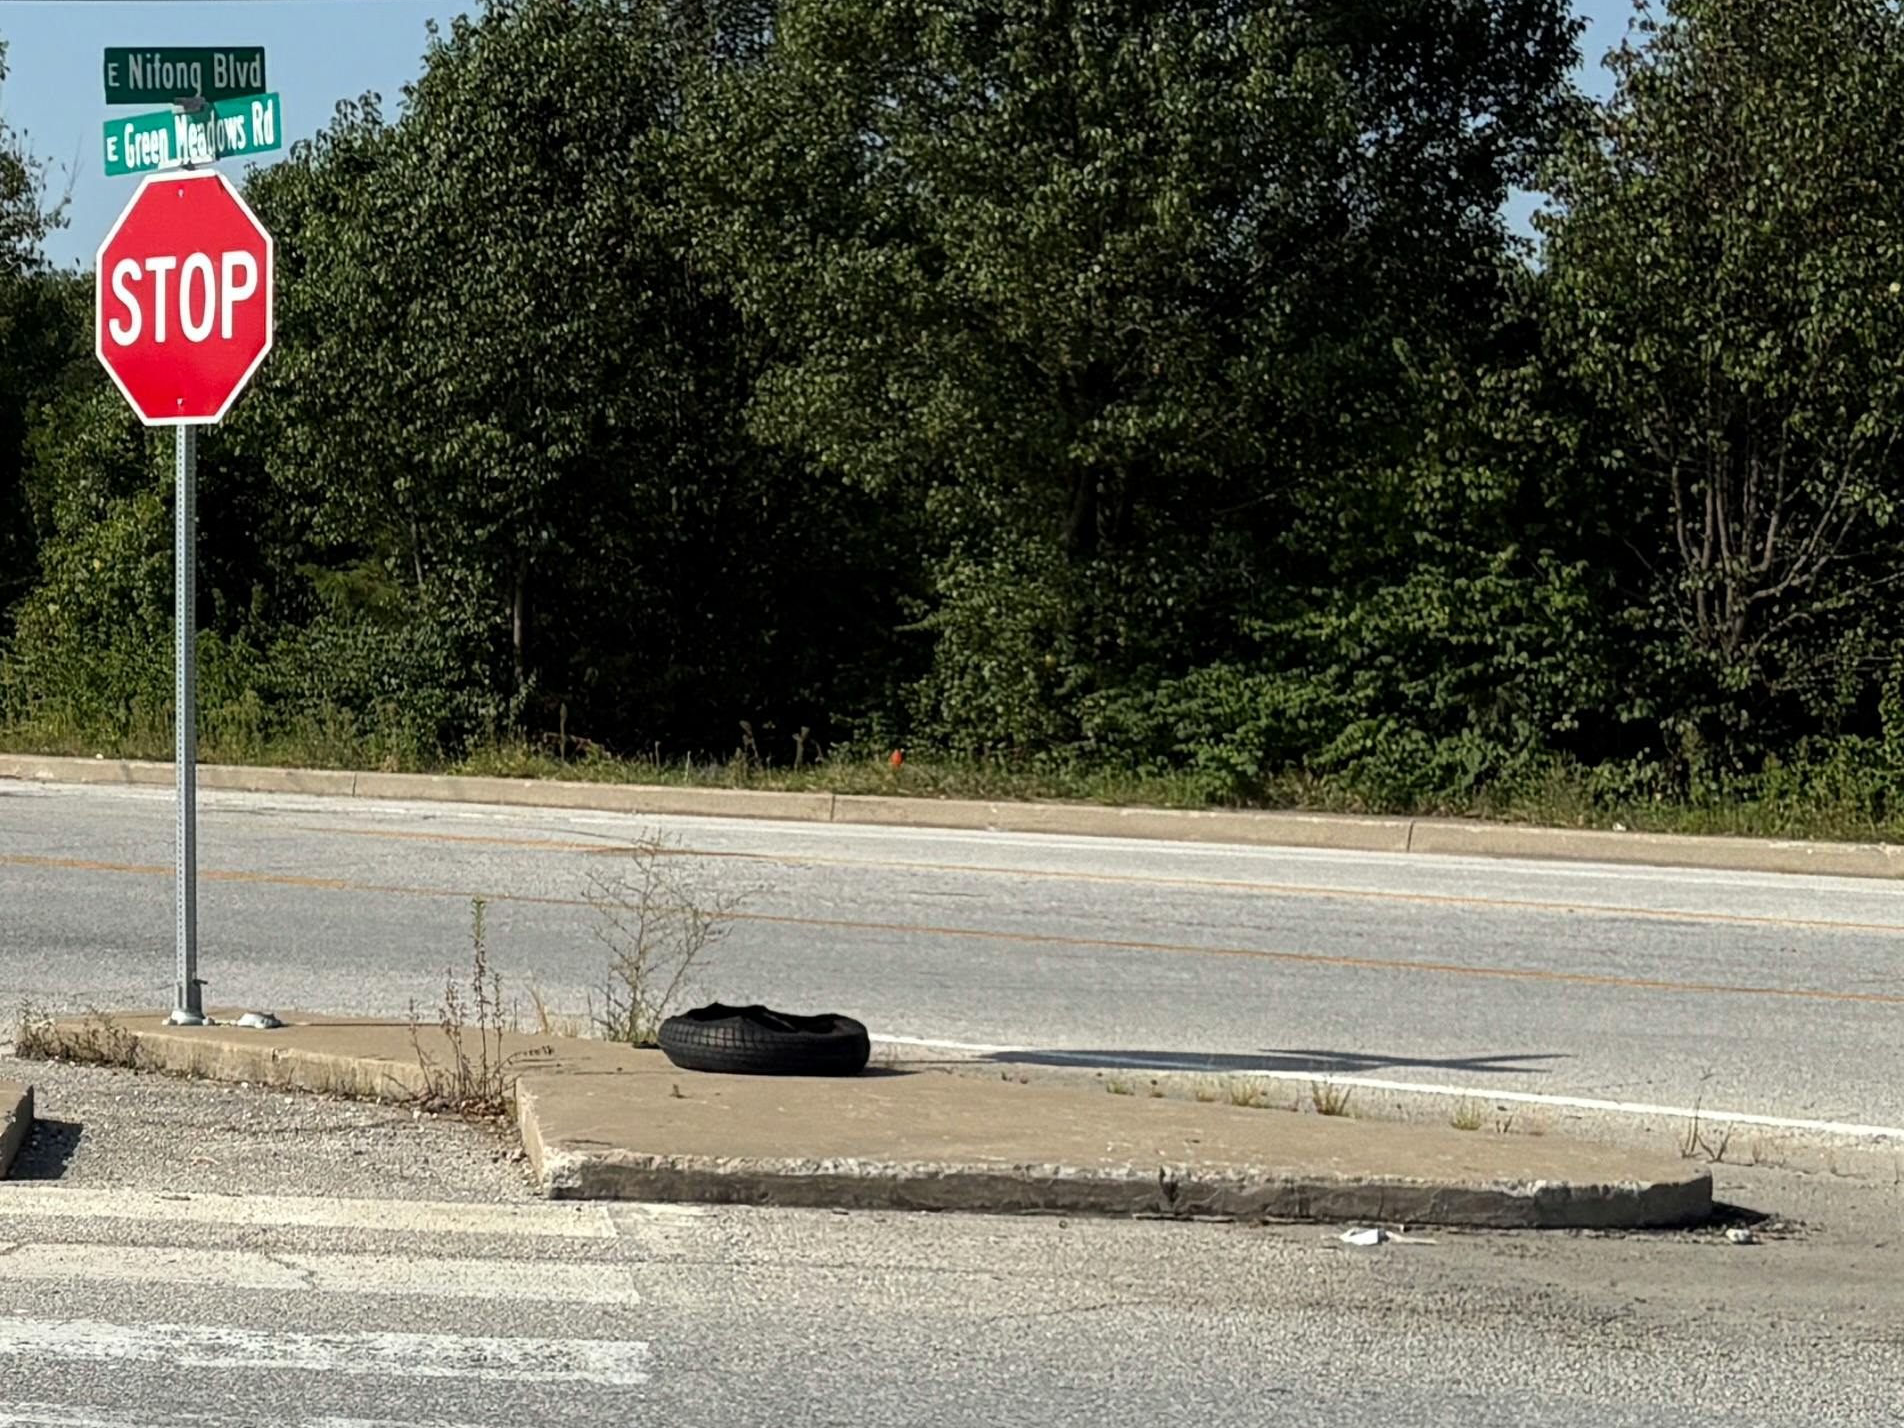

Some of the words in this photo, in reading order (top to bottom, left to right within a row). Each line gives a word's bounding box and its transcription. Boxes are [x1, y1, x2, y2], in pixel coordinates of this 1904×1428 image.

[107, 63, 120, 87] E
[128, 53, 202, 98] Nifong
[213, 52, 262, 88] Blvd
[106, 136, 119, 162] E
[124, 123, 169, 168] Green
[174, 109, 247, 164] Meadows
[251, 99, 275, 147] Rd
[109, 250, 258, 347] STOP
